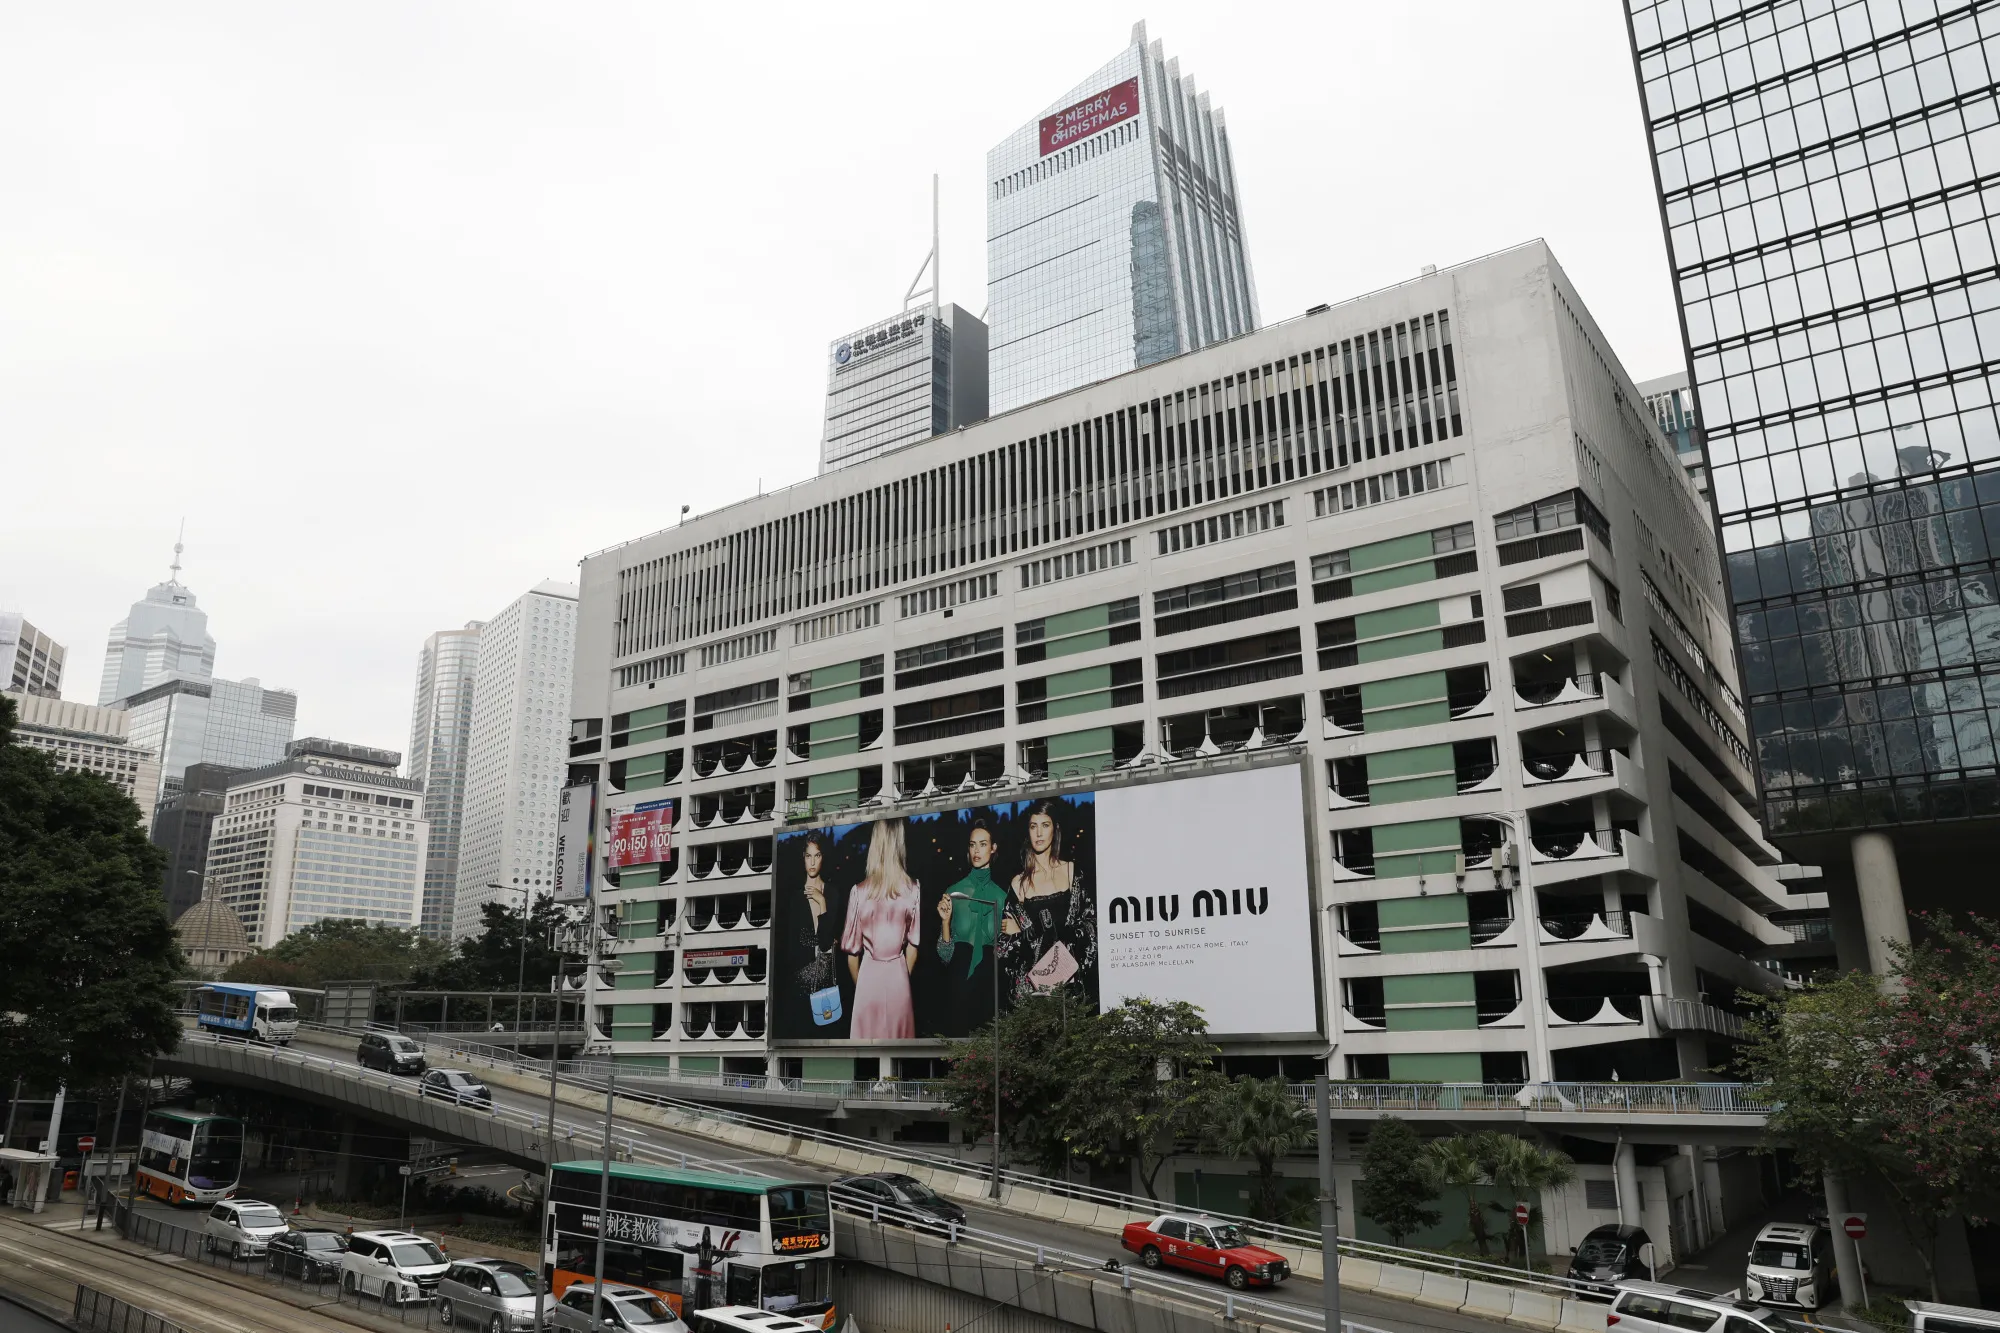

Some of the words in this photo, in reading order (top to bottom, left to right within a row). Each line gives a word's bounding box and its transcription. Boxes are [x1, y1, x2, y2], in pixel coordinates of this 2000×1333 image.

[1065, 94, 1111, 125] MERRY
[1051, 102, 1128, 145] CHRISTMAS
[324, 769, 374, 784] MANDARIN
[374, 777, 415, 791] ORIENTAL
[611, 838, 627, 853] $90
[627, 835, 648, 851] $150
[649, 832, 671, 848] $100
[556, 835, 566, 892] WELCOME
[1109, 931, 1145, 941] SUNSET
[1148, 930, 1160, 938] TO
[1164, 927, 1206, 937] SUNRISE
[1176, 942, 1202, 950] ANTICA
[1121, 960, 1156, 968] ALASDAIR
[1158, 959, 1195, 967] McLELLAN
[605, 1212, 660, 1244] 刺客教條
[803, 1238, 819, 1248] 722
